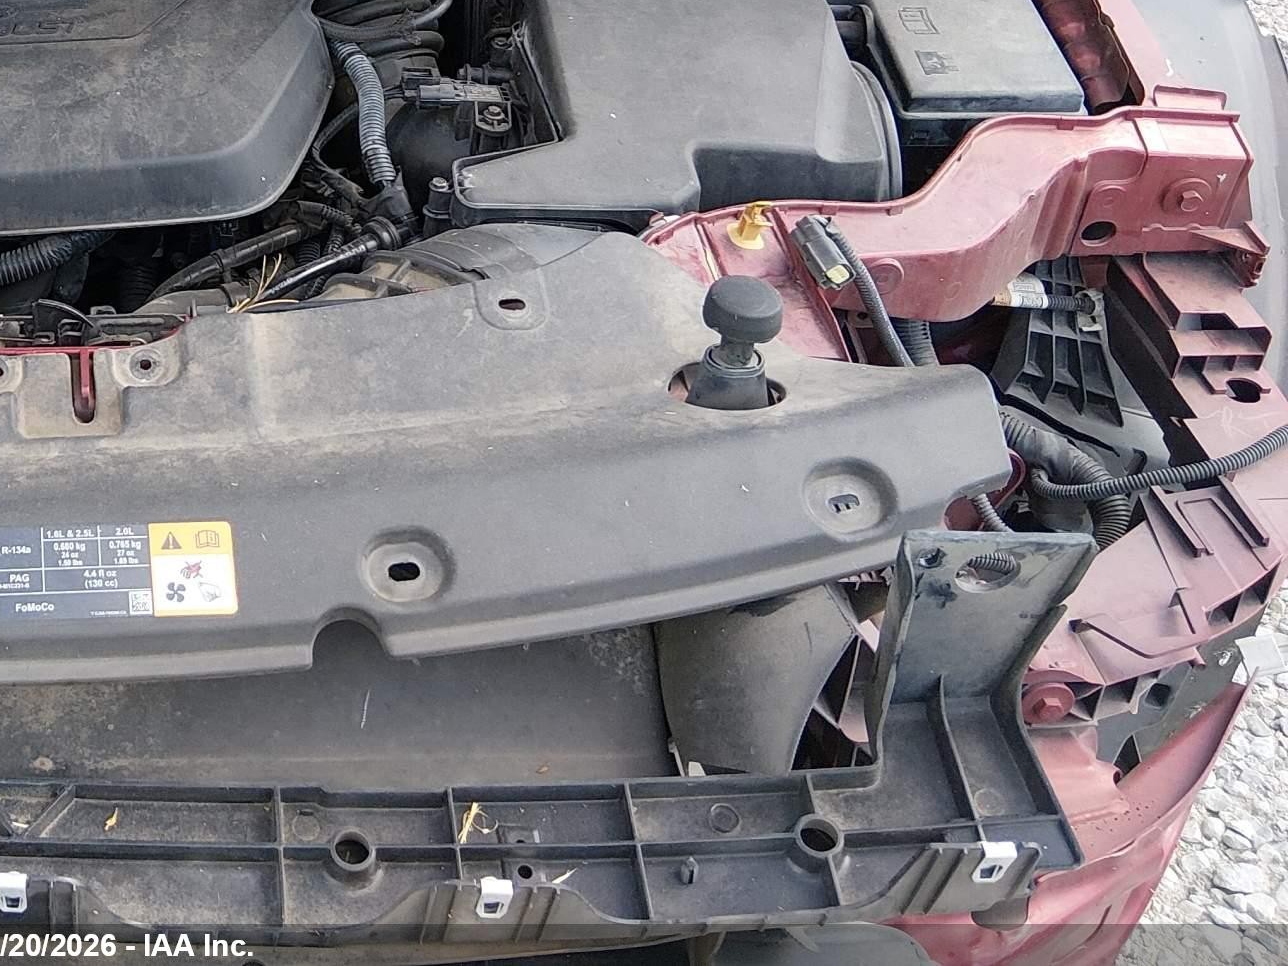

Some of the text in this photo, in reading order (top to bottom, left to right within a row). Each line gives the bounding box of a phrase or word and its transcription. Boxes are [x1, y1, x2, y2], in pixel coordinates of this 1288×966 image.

[76, 528, 95, 537] 2.5L
[115, 527, 134, 535] 2.0L
[1, 545, 32, 555] R-134a
[75, 542, 86, 552] kg
[131, 540, 142, 550] kg
[9, 573, 30, 583] PAG
[98, 569, 105, 577] fl
[84, 578, 118, 589] (130 cc)
[15, 602, 55, 613] FoMoCo
